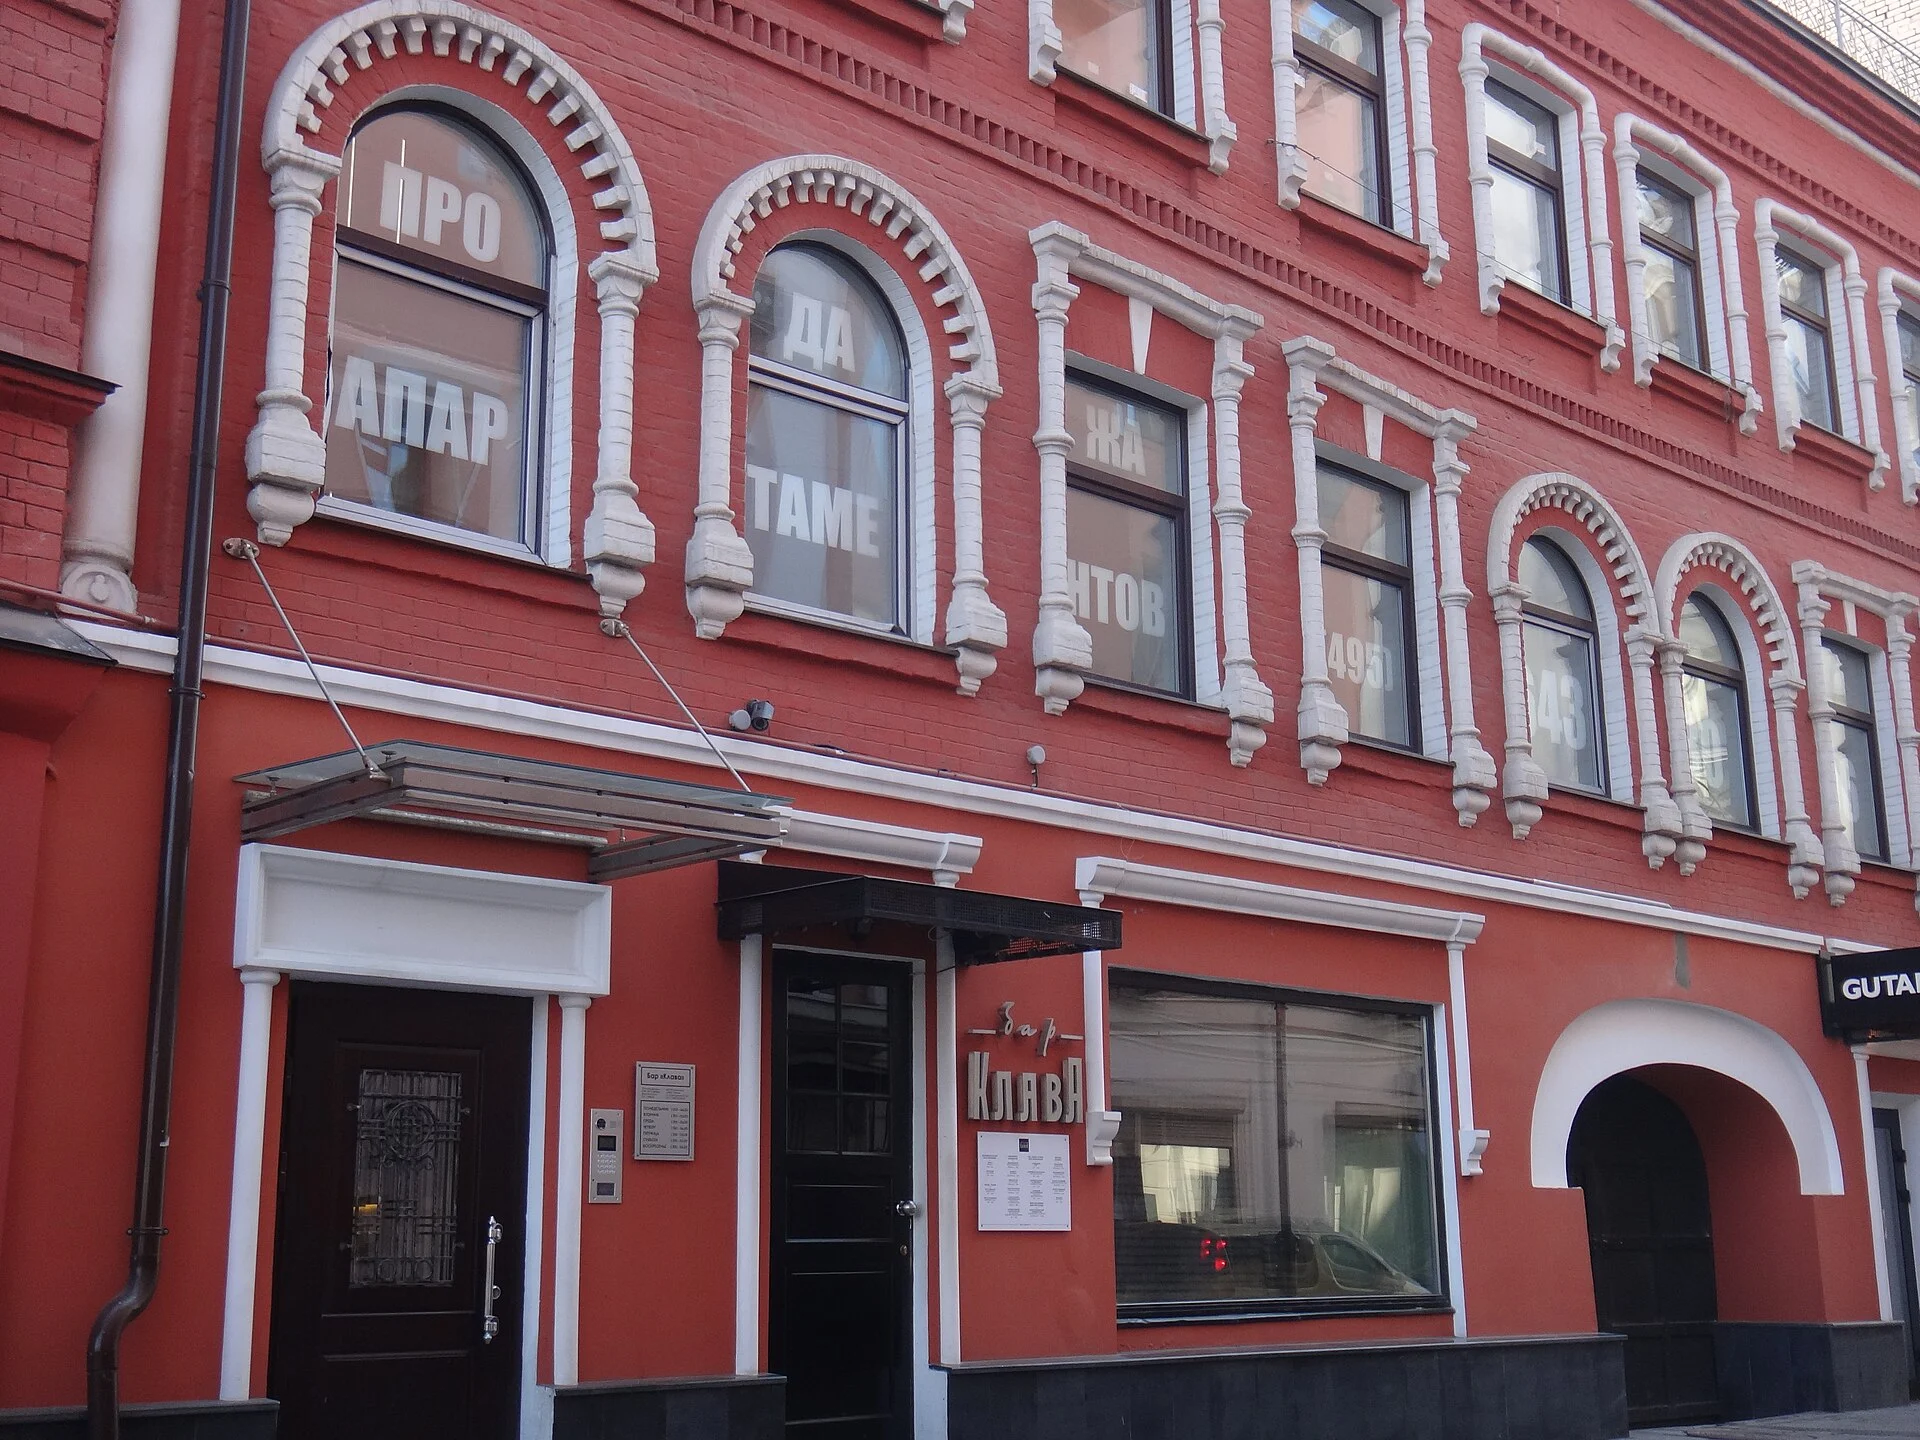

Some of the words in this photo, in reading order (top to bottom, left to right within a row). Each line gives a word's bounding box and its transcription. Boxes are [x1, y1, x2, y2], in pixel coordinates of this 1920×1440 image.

[380, 160, 501, 263] ПРО
[783, 291, 855, 373] ДА
[335, 355, 509, 466] АПАР
[1086, 404, 1146, 477] ЖА
[746, 463, 880, 559] ТАМЕ
[1067, 558, 1166, 638] НТОВ
[647, 1072, 659, 1080] Бар
